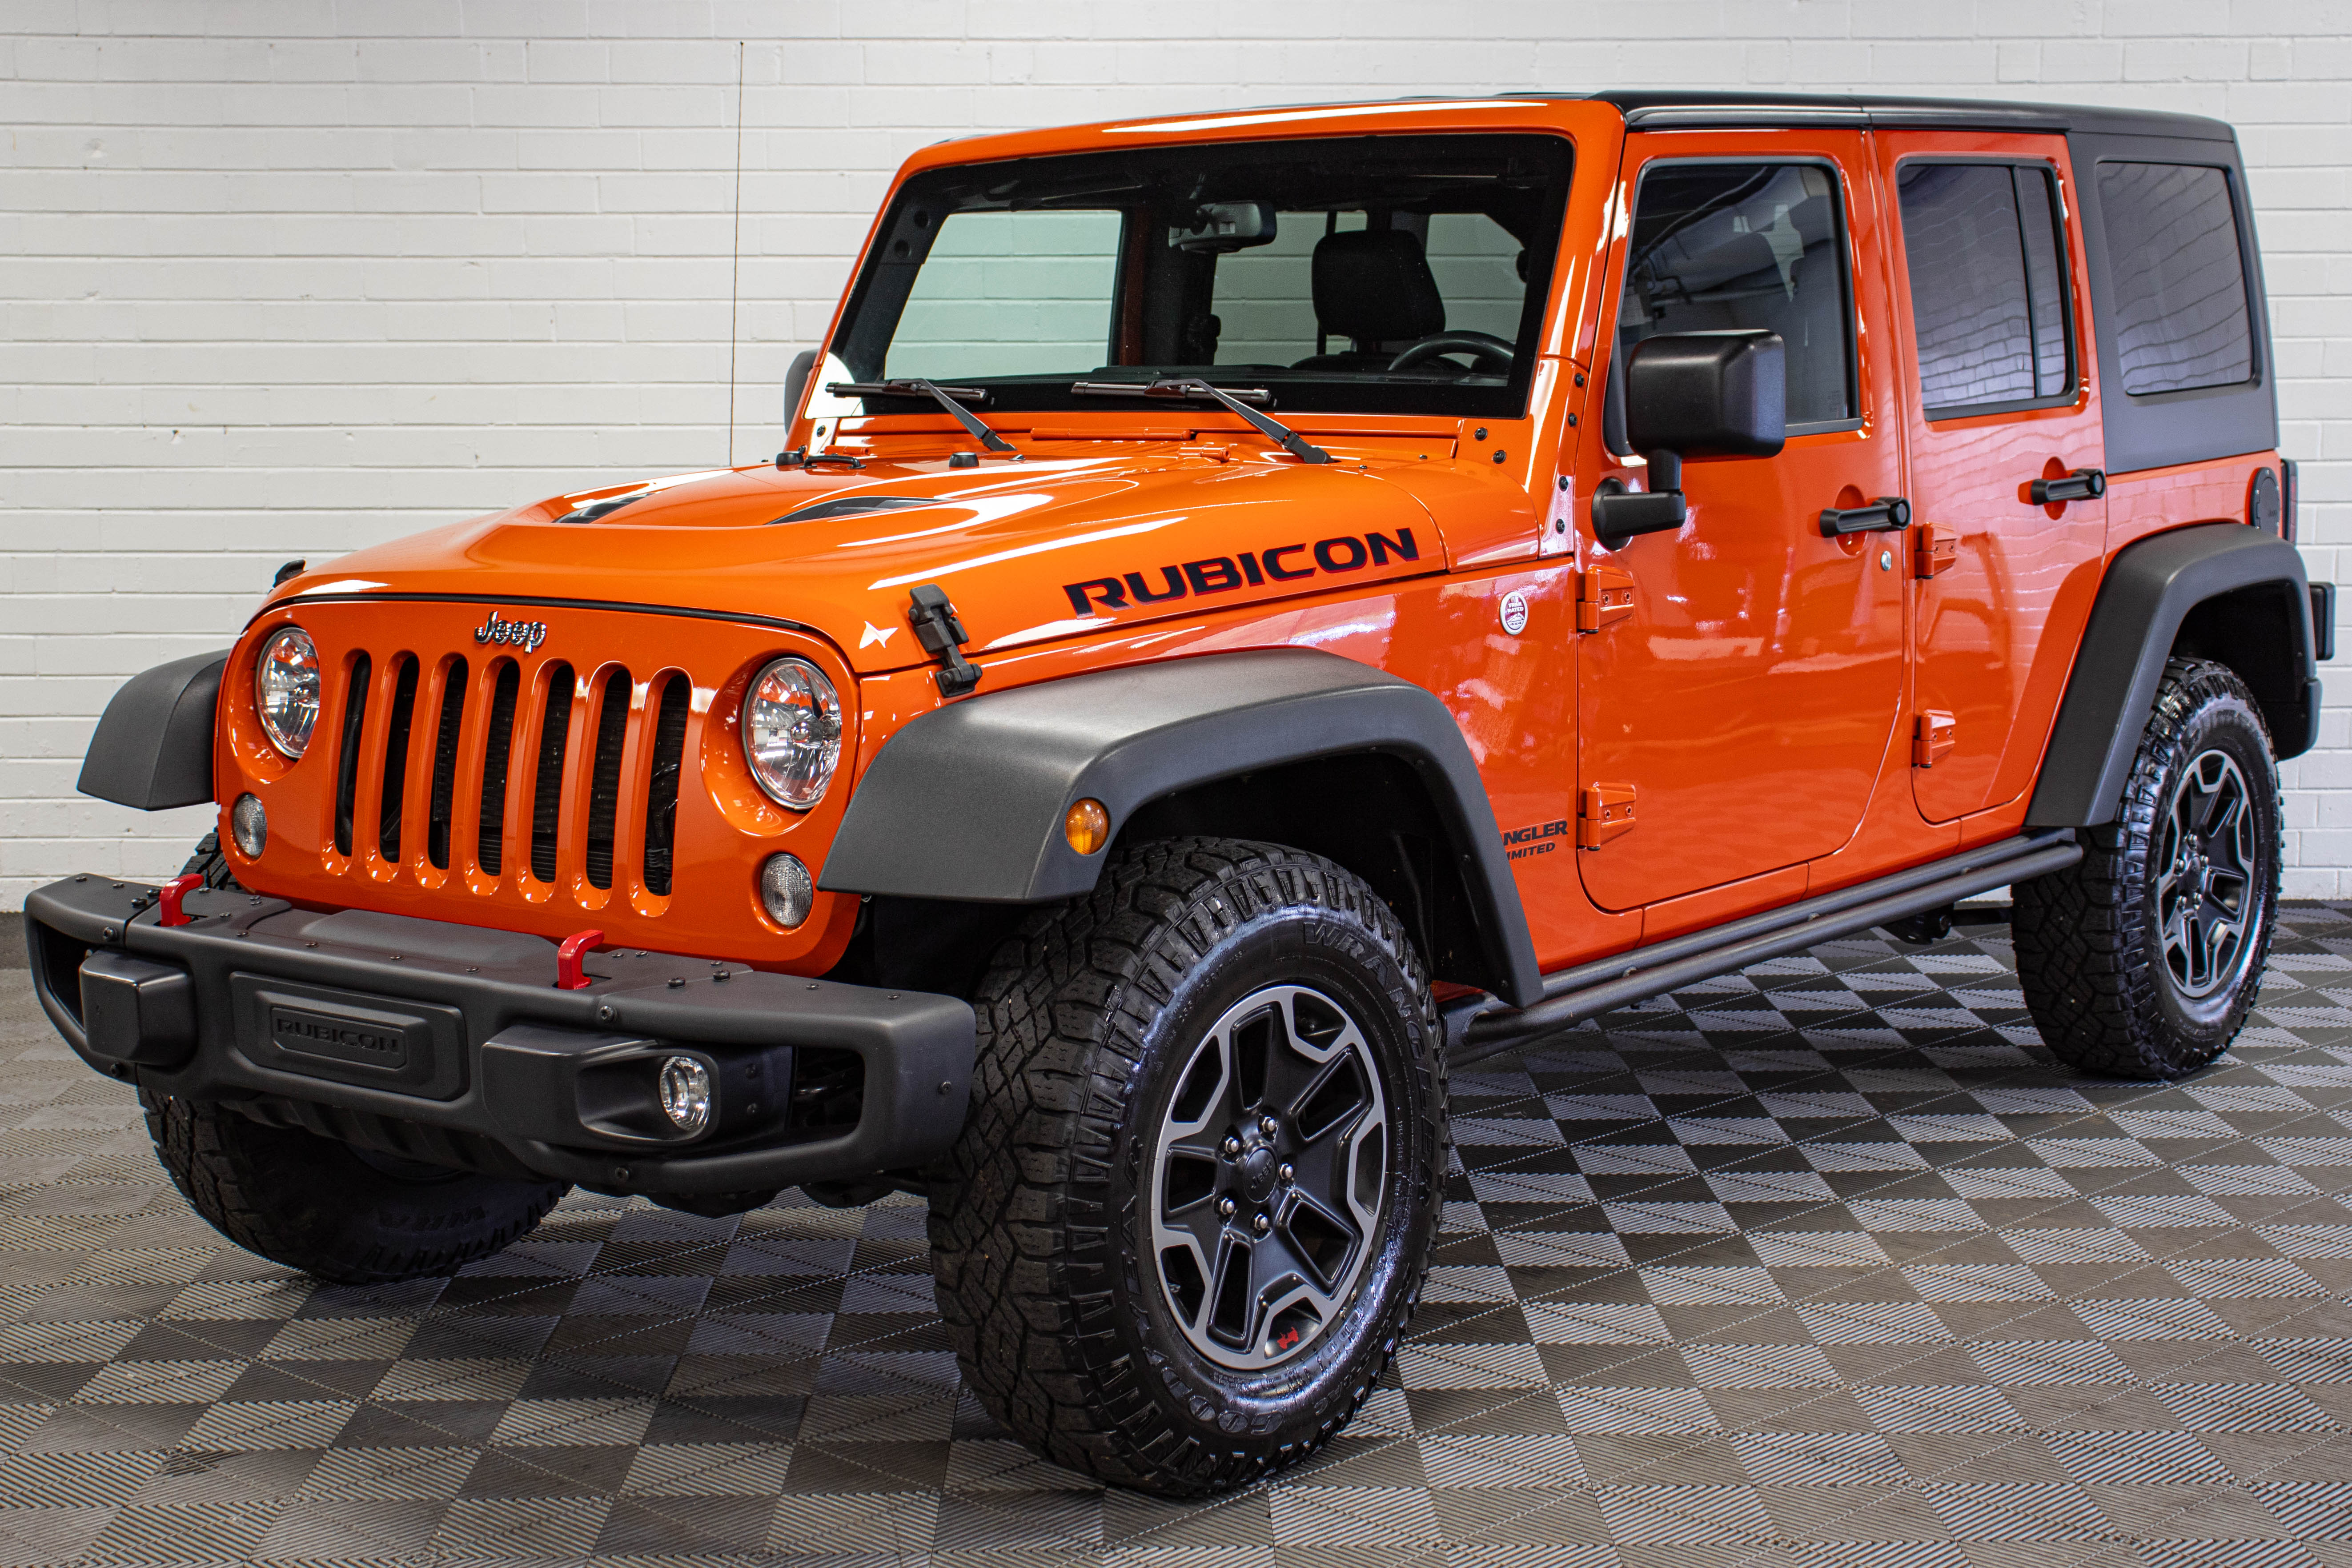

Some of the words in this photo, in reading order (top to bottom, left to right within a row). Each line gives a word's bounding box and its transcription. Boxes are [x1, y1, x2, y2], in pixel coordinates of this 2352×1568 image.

[1062, 527, 1420, 618] RUBICON
[474, 611, 547, 654] Jeep
[1501, 820, 1568, 846] NGLER
[1506, 842, 1555, 861] IMITED
[277, 1018, 400, 1055] RUBICON
[1250, 1159, 1272, 1189] Jeep
